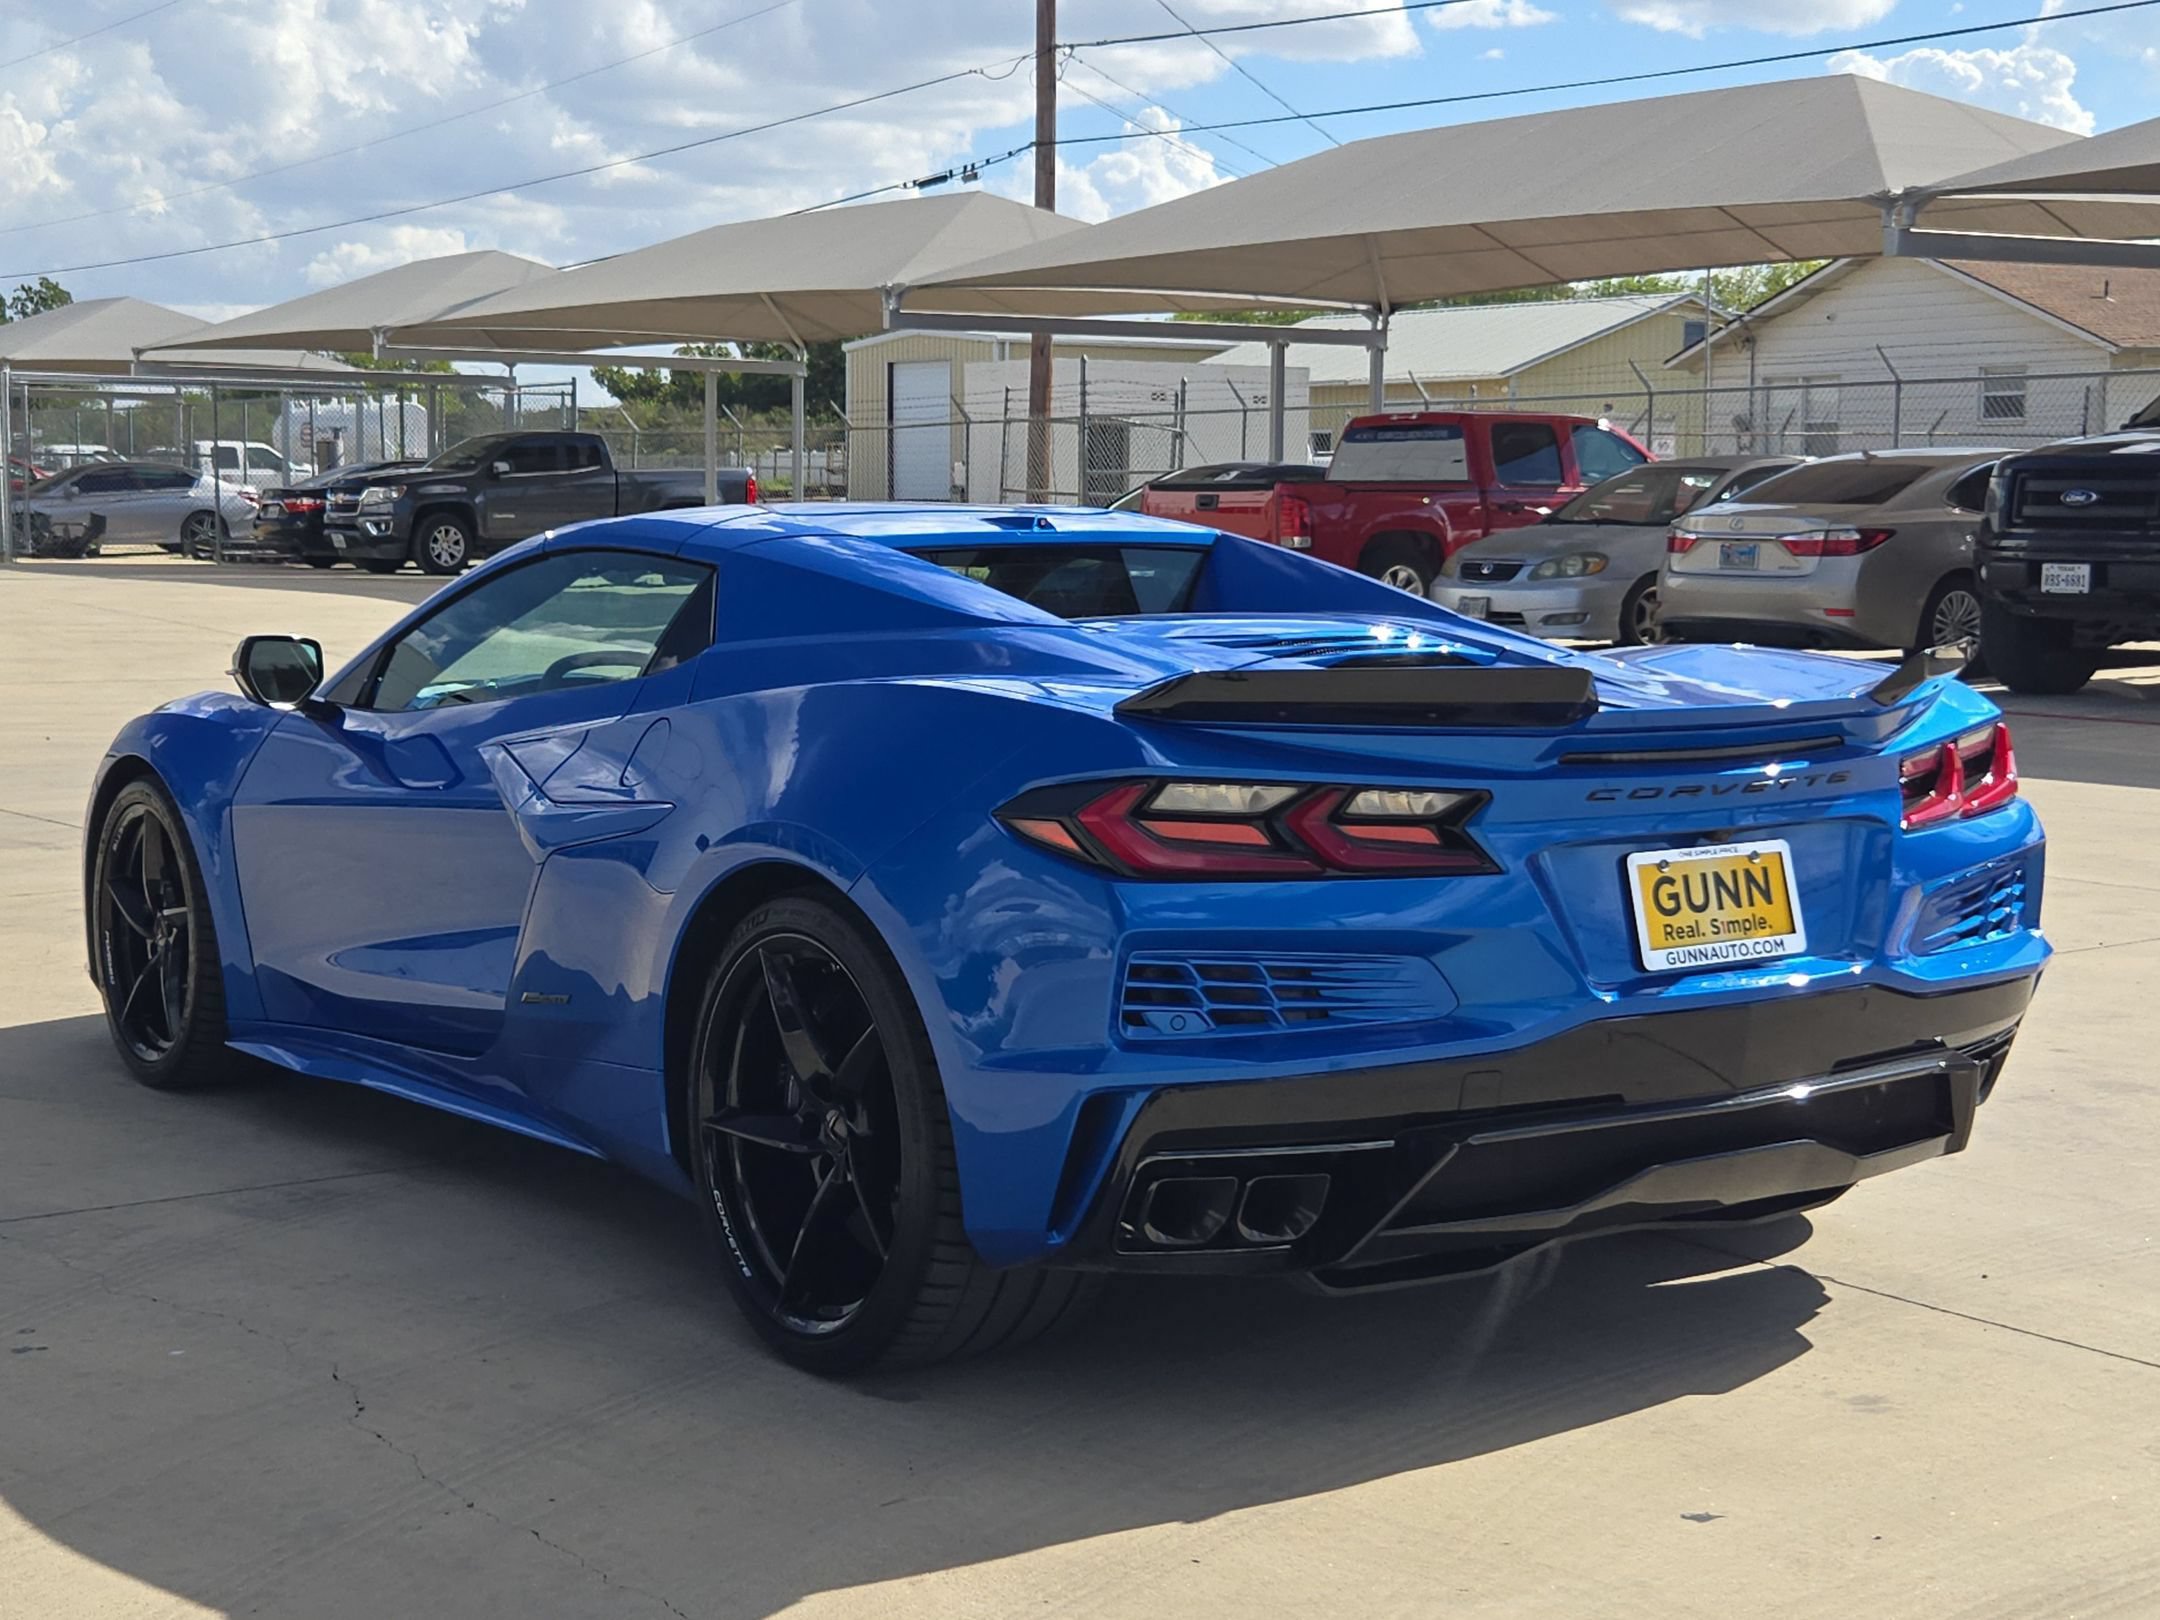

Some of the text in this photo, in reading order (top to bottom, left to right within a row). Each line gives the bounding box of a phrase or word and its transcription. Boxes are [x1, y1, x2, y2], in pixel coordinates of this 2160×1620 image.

[1585, 770, 1851, 801] CORVETTE
[1678, 846, 1739, 858] ONE SIMPLE PRICE
[1652, 866, 1774, 917] GUNN
[1662, 919, 1706, 942] Real.
[1666, 938, 1786, 966] GUNNAUTO.COM
